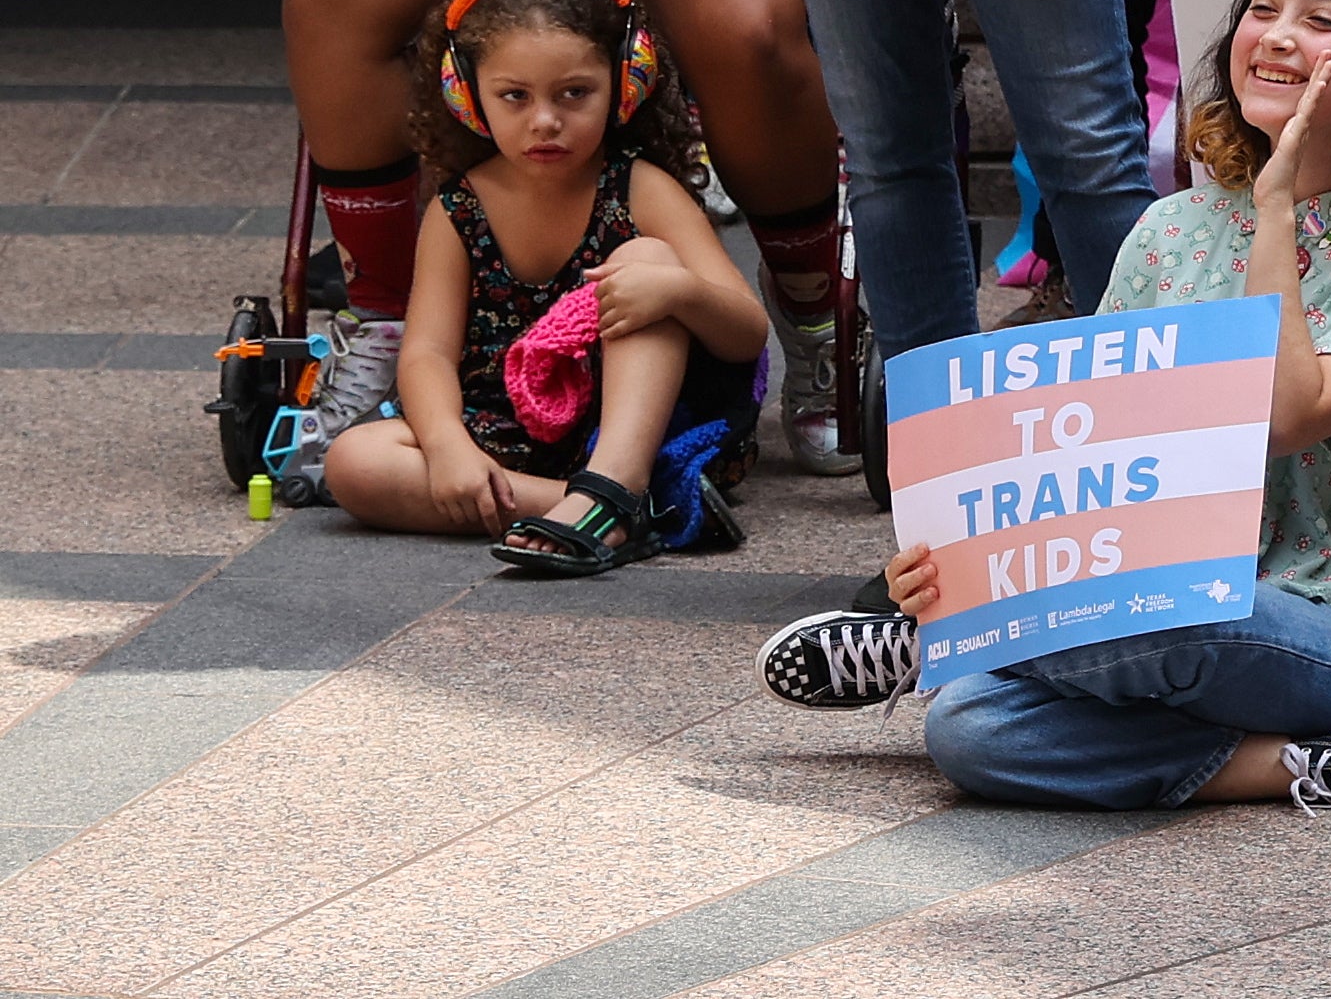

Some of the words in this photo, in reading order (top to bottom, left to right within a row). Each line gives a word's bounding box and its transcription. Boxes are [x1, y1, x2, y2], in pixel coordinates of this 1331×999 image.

[949, 323, 1178, 406] LISTEN
[1012, 401, 1094, 457] TO
[958, 456, 1160, 538] TRANS
[988, 527, 1123, 602] KIDS
[1059, 605, 1092, 620] Lambda
[1093, 599, 1115, 614] Legal
[928, 639, 950, 661] ACLU
